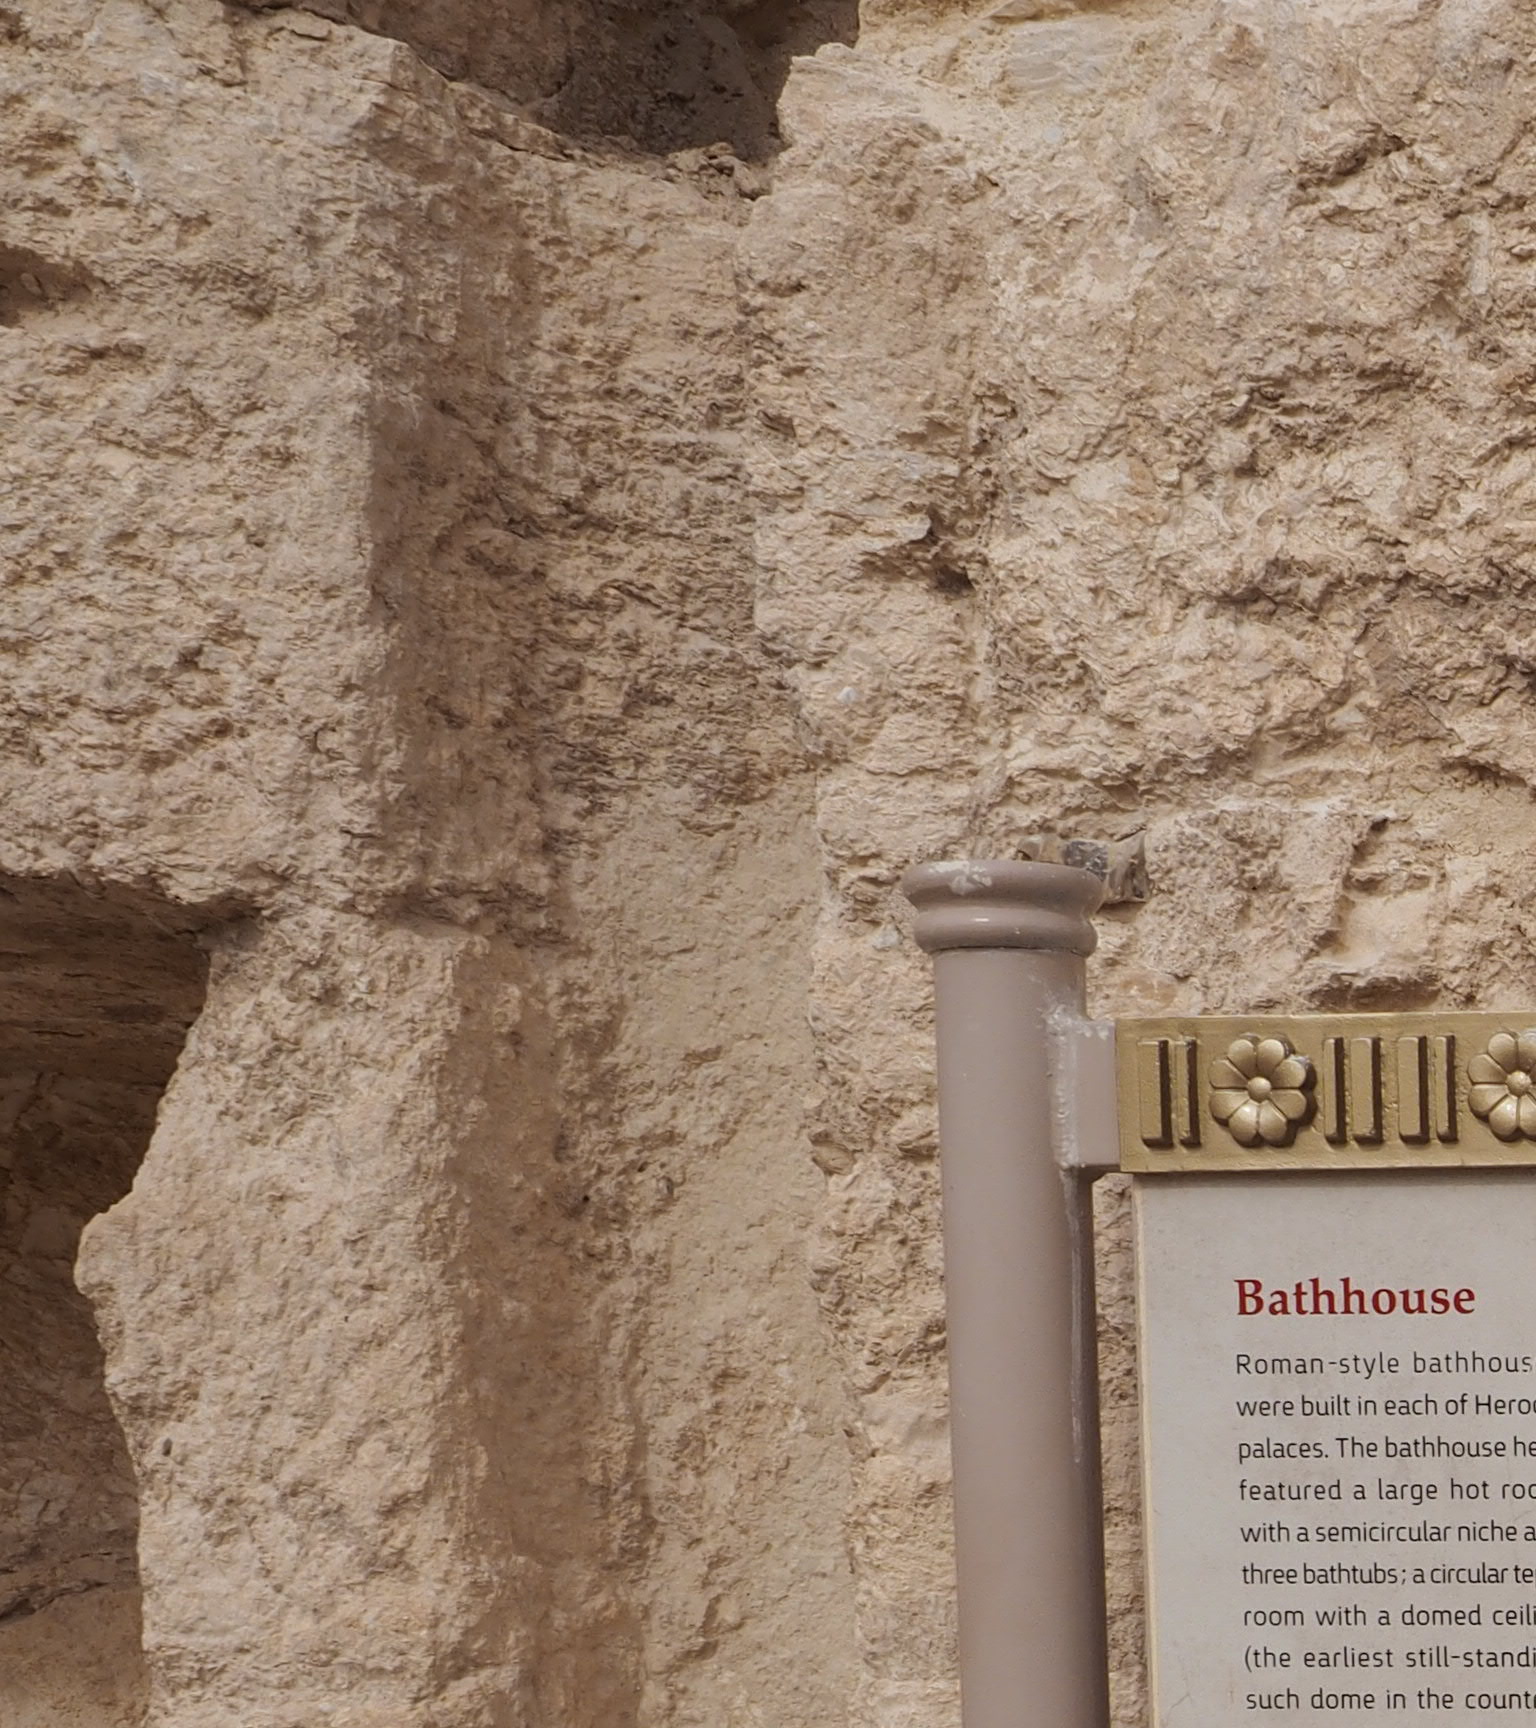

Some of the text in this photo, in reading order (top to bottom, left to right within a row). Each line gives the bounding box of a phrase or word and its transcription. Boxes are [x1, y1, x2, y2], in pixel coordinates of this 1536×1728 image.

[1234, 1277, 1475, 1316] Bathhouse
[1236, 1352, 1399, 1380] Roman-style
[1236, 1401, 1294, 1416] were
[1301, 1394, 1351, 1416] built
[1358, 1396, 1377, 1416] in
[1384, 1393, 1437, 1416] each
[1445, 1393, 1468, 1415] of
[1239, 1437, 1328, 1465] palaces.
[1335, 1436, 1378, 1458] The
[1385, 1435, 1506, 1458] bathhouse
[1239, 1479, 1342, 1501] featured
[1353, 1485, 1366, 1500] a
[1378, 1478, 1438, 1506] large
[1450, 1477, 1490, 1500] hot
[1240, 1521, 1290, 1543] with
[1297, 1527, 1310, 1542] a
[1316, 1520, 1452, 1542] semicircular
[1458, 1519, 1517, 1542] niche
[1241, 1562, 1298, 1584] three
[1303, 1562, 1406, 1585] bathtubs;
[1413, 1568, 1426, 1584] a
[1430, 1562, 1509, 1584] circular
[1244, 1610, 1304, 1626] room
[1315, 1604, 1366, 1626] with
[1378, 1610, 1391, 1626] a
[1402, 1604, 1482, 1626] domed
[1245, 1645, 1291, 1673] (the
[1304, 1646, 1394, 1668] earliest
[1246, 1688, 1299, 1709] such
[1311, 1687, 1375, 1709] dome
[1386, 1689, 1406, 1709] in
[1417, 1687, 1454, 1709] the
